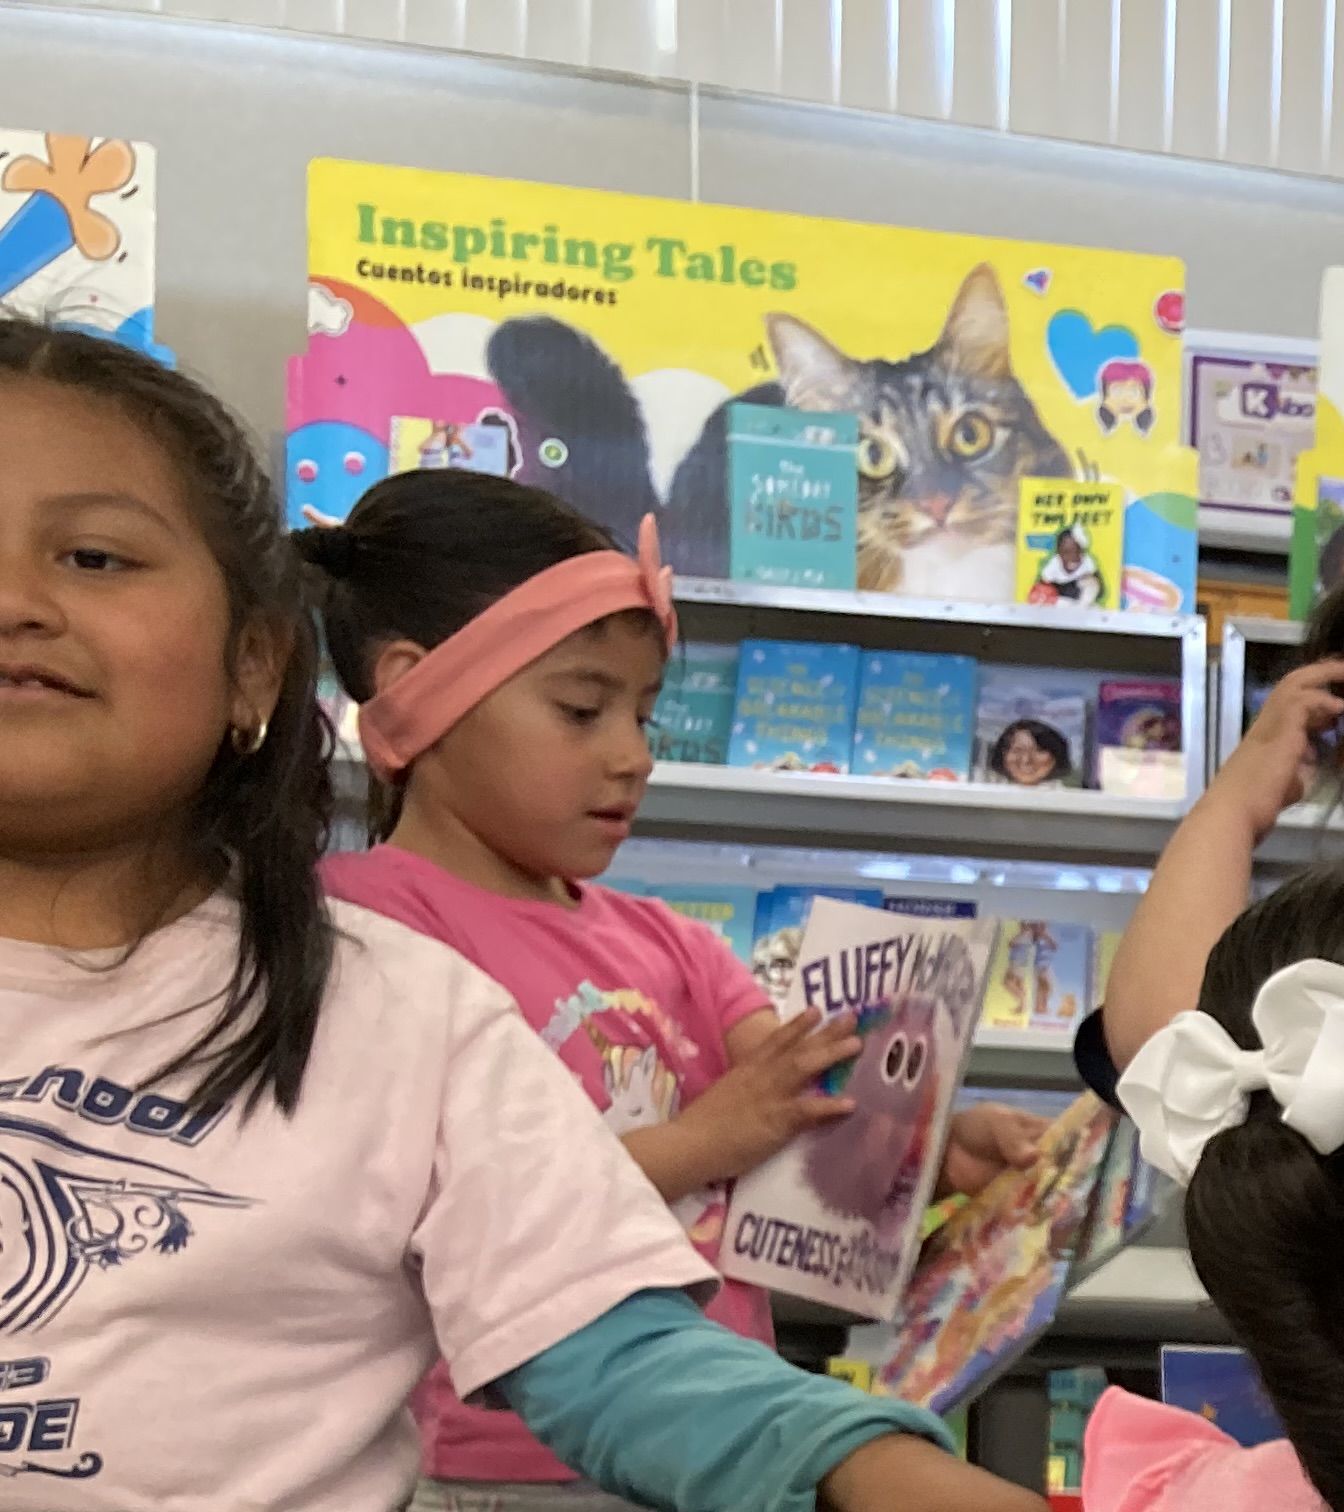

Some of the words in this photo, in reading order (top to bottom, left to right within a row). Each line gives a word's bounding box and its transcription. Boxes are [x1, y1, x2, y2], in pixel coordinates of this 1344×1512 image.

[356, 258, 453, 288] Cuentos
[461, 264, 618, 307] inspiradores
[357, 203, 635, 282] Inspiring
[646, 236, 798, 292] Tales
[802, 932, 916, 1013] FLUFFY
